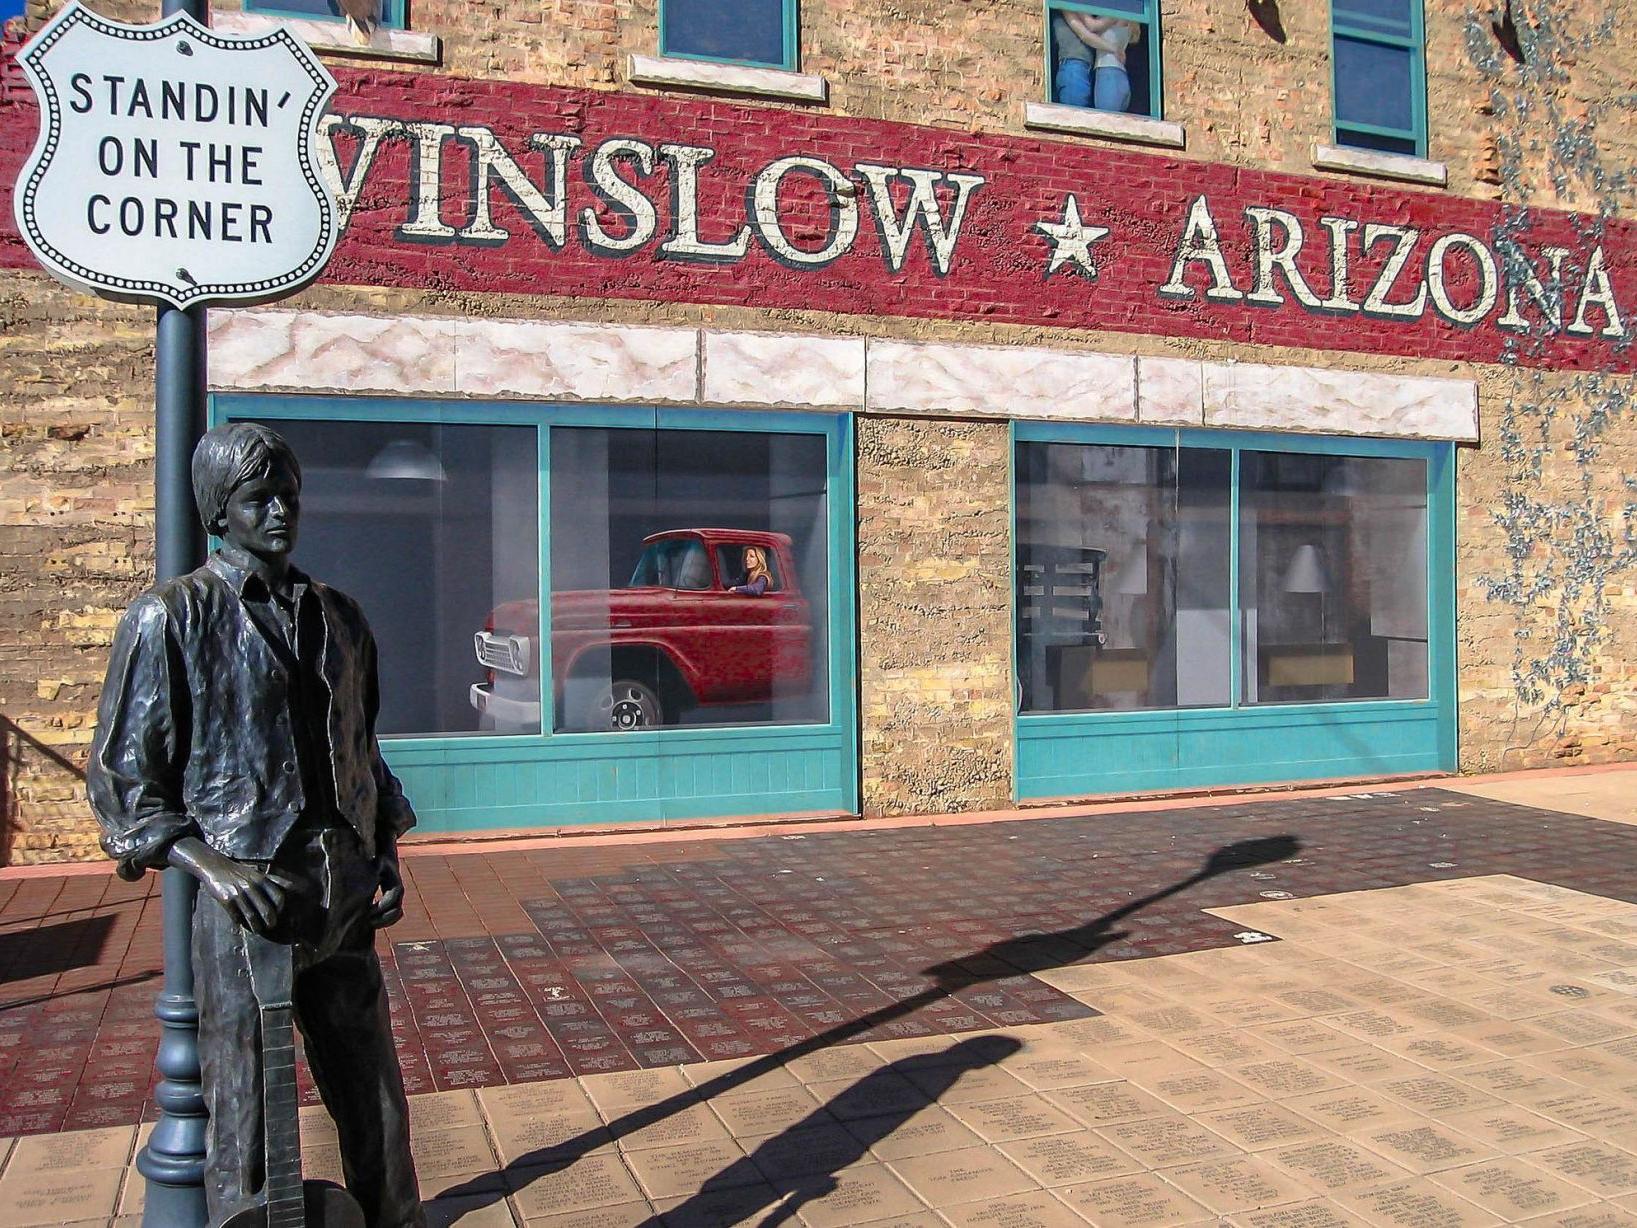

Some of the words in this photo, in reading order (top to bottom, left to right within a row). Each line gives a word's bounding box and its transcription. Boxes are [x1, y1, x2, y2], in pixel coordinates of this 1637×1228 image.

[70, 73, 291, 127] STANDIN'
[99, 136, 158, 179] ON
[180, 141, 263, 186] THE
[87, 194, 273, 244] CORNER
[1160, 194, 1625, 337] ARIZONA
